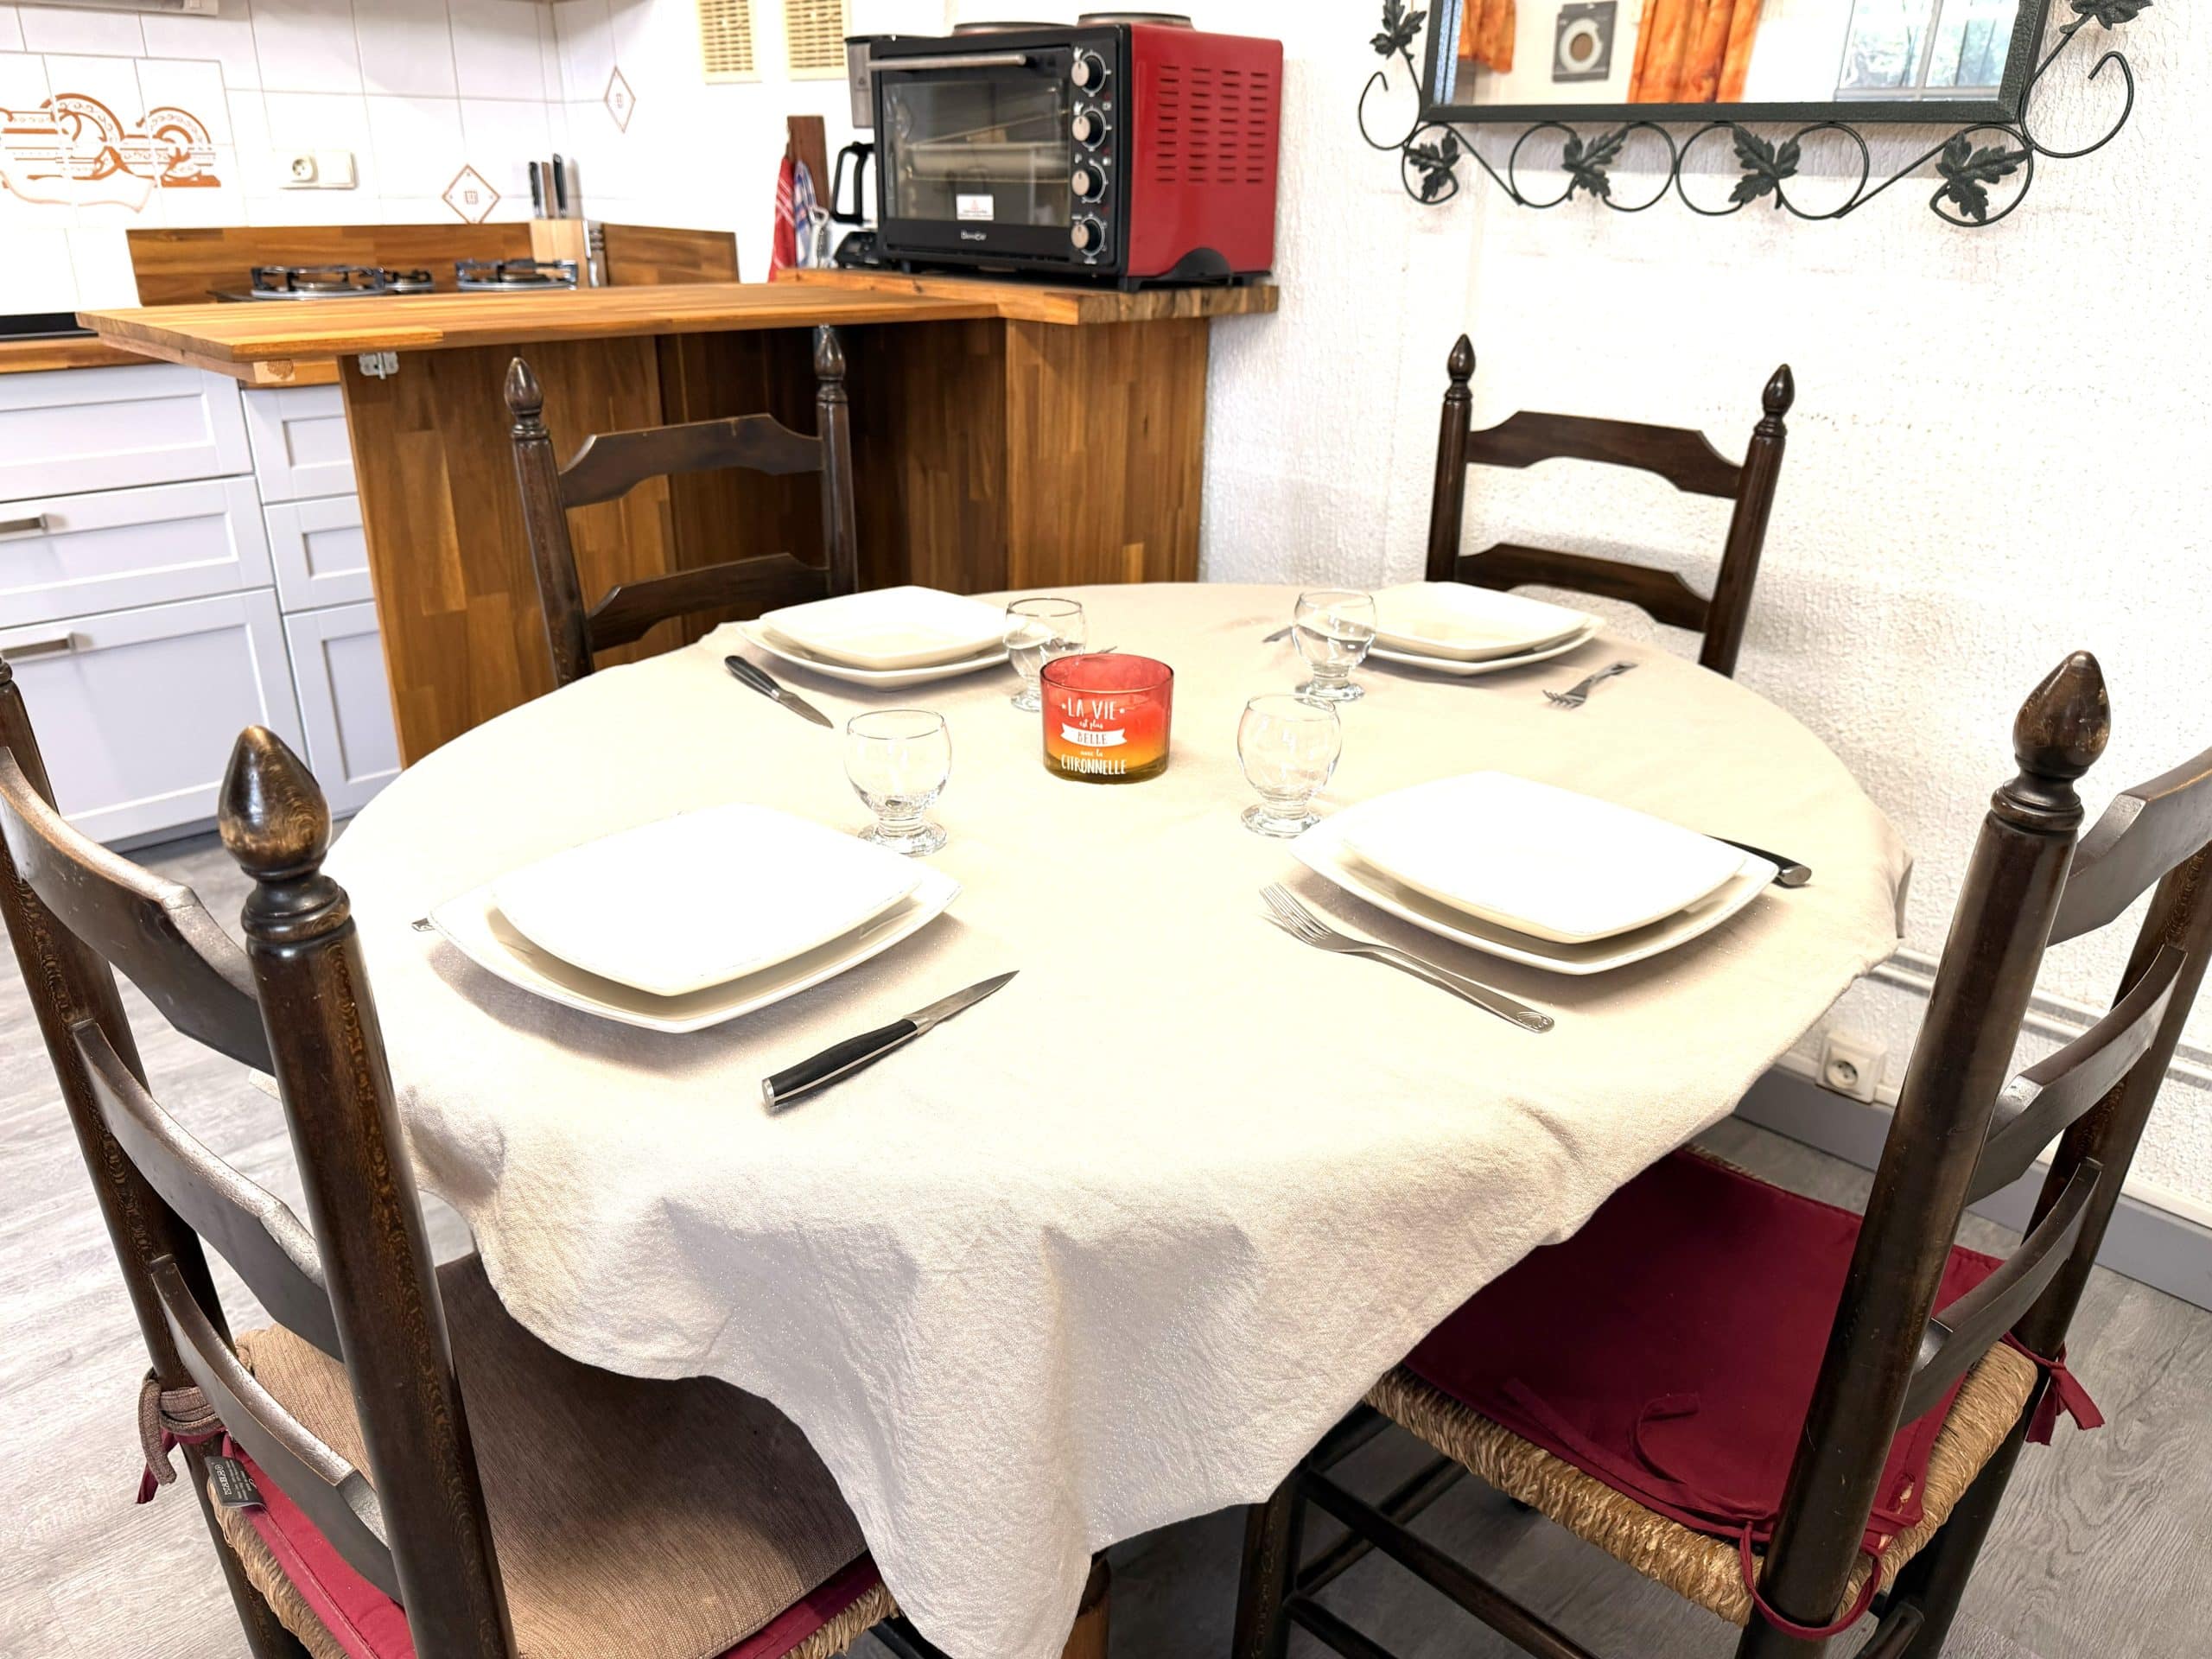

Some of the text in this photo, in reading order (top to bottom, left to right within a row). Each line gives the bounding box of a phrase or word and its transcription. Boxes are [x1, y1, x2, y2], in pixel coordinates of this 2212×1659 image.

[1067, 697, 1117, 721] LA VIE
[1077, 731, 1108, 745] BELLE
[1061, 753, 1128, 775] CITRONNELLE
